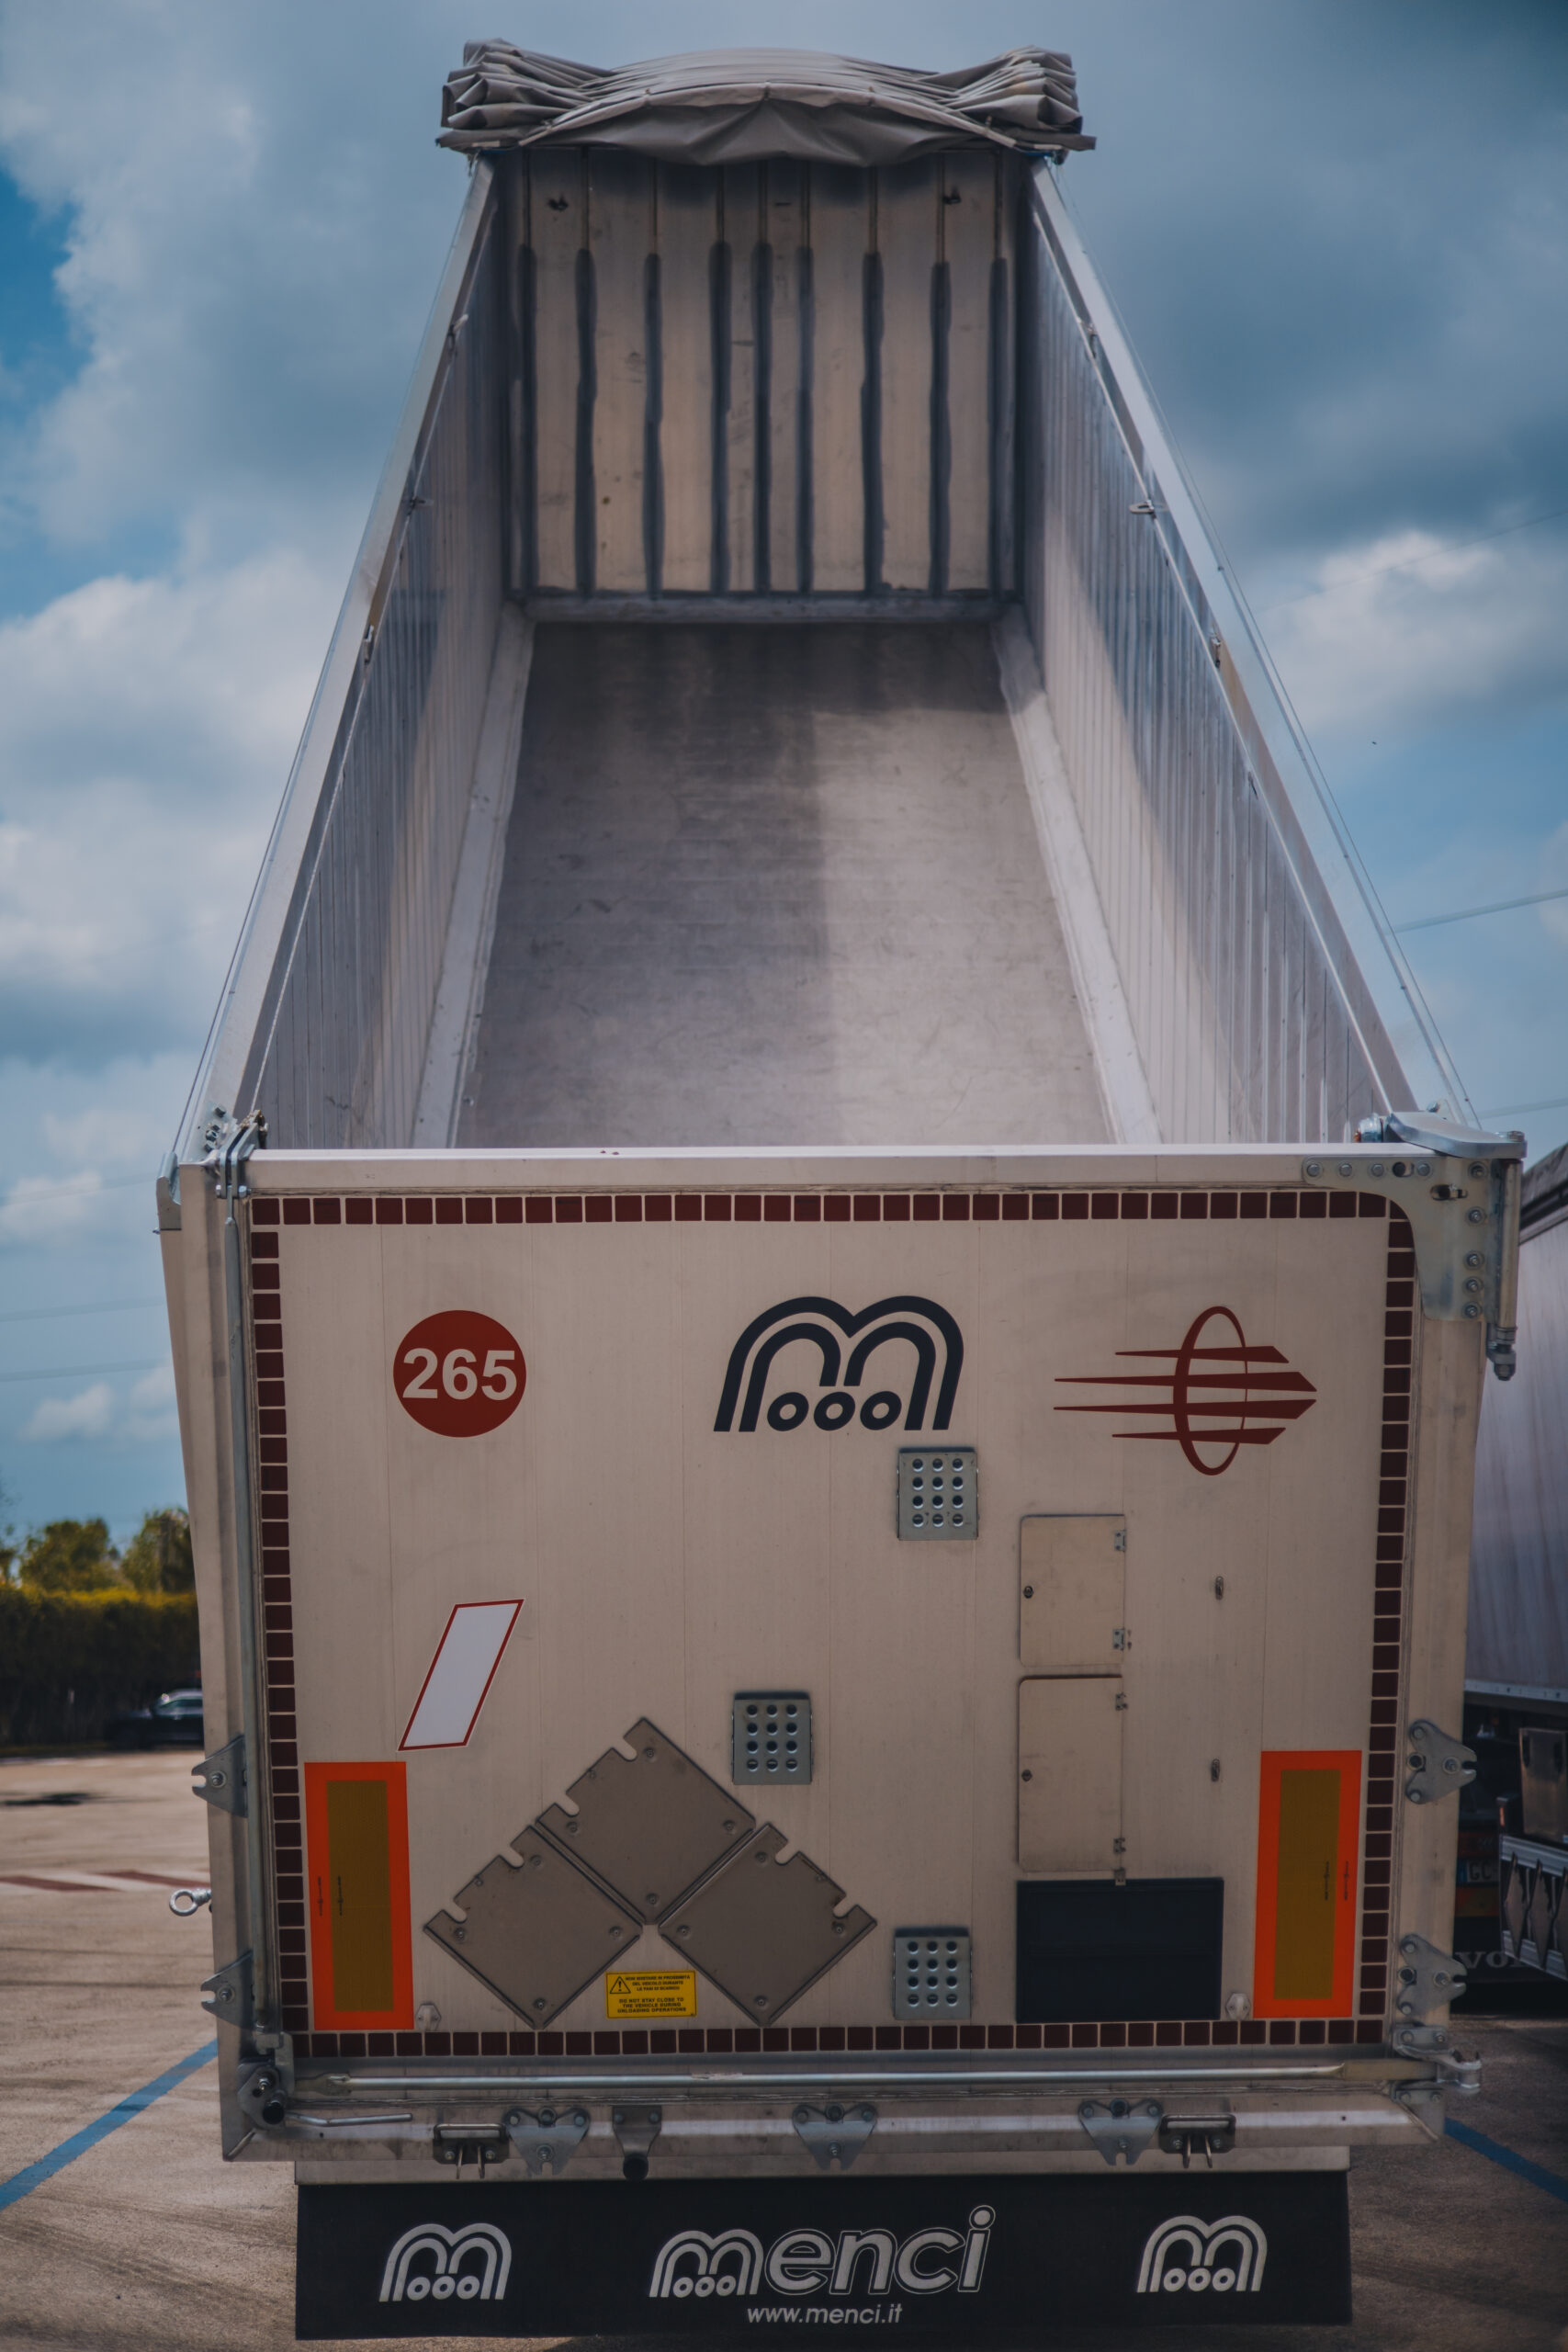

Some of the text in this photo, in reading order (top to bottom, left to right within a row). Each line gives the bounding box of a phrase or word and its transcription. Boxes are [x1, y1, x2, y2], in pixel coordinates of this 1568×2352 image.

[402, 1348, 517, 1401] 265
[649, 2206, 995, 2298] menci
[747, 2303, 902, 2324] www.menci.it
